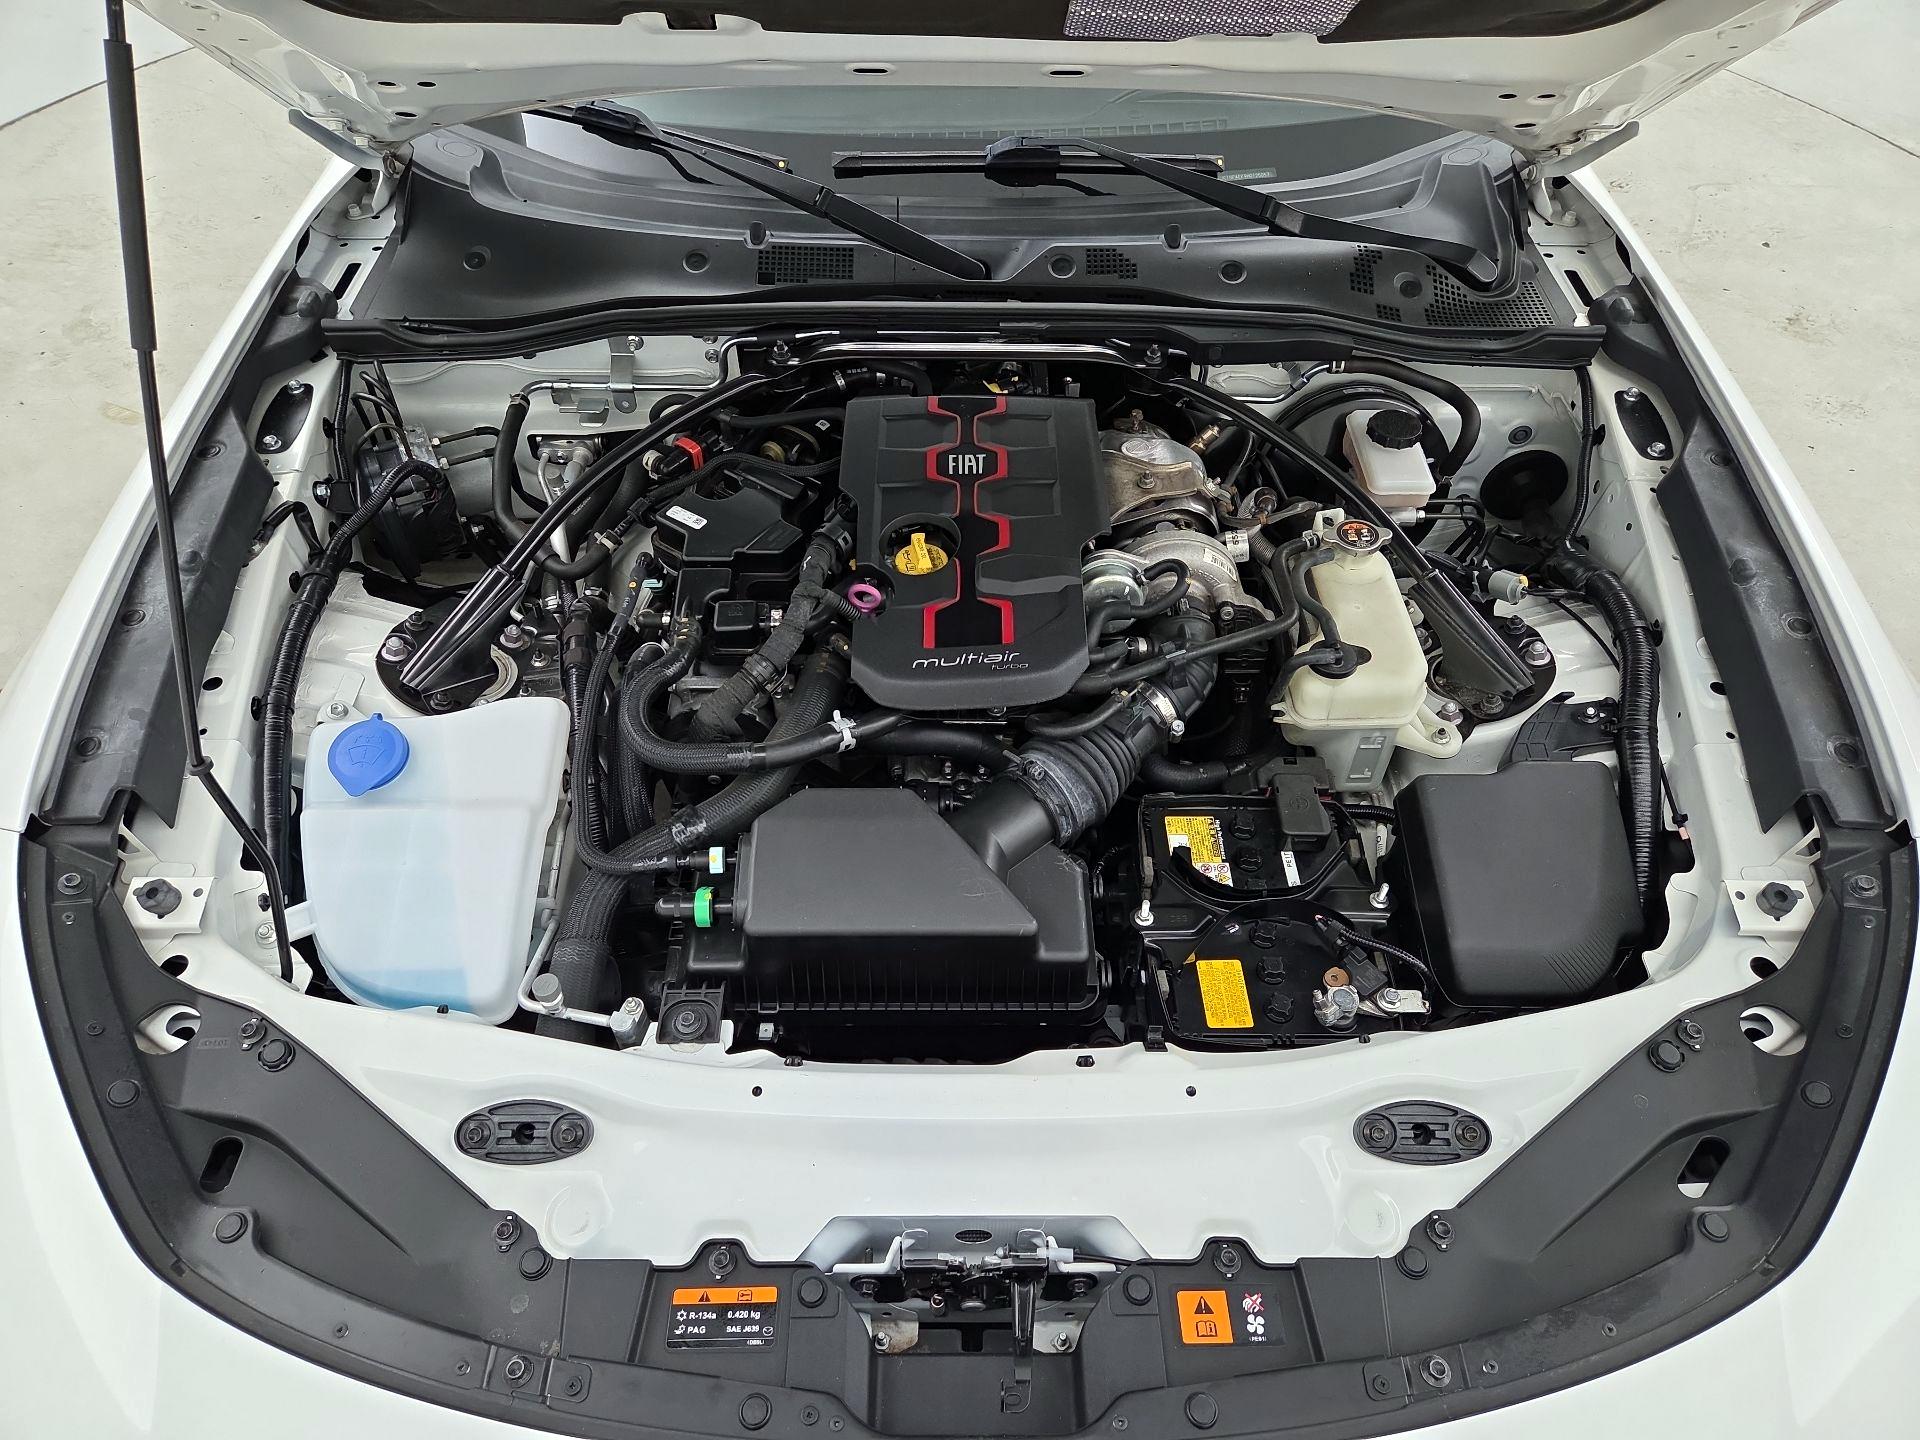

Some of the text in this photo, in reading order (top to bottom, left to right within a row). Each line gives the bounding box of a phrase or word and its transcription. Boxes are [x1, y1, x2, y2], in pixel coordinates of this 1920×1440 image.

[948, 453, 987, 475] FIAT
[911, 650, 1021, 669] multiair
[991, 663, 1029, 671] turbo
[688, 1310, 761, 1320] R-134a 0.420 kg
[687, 1324, 760, 1334] PAG SAE J639
